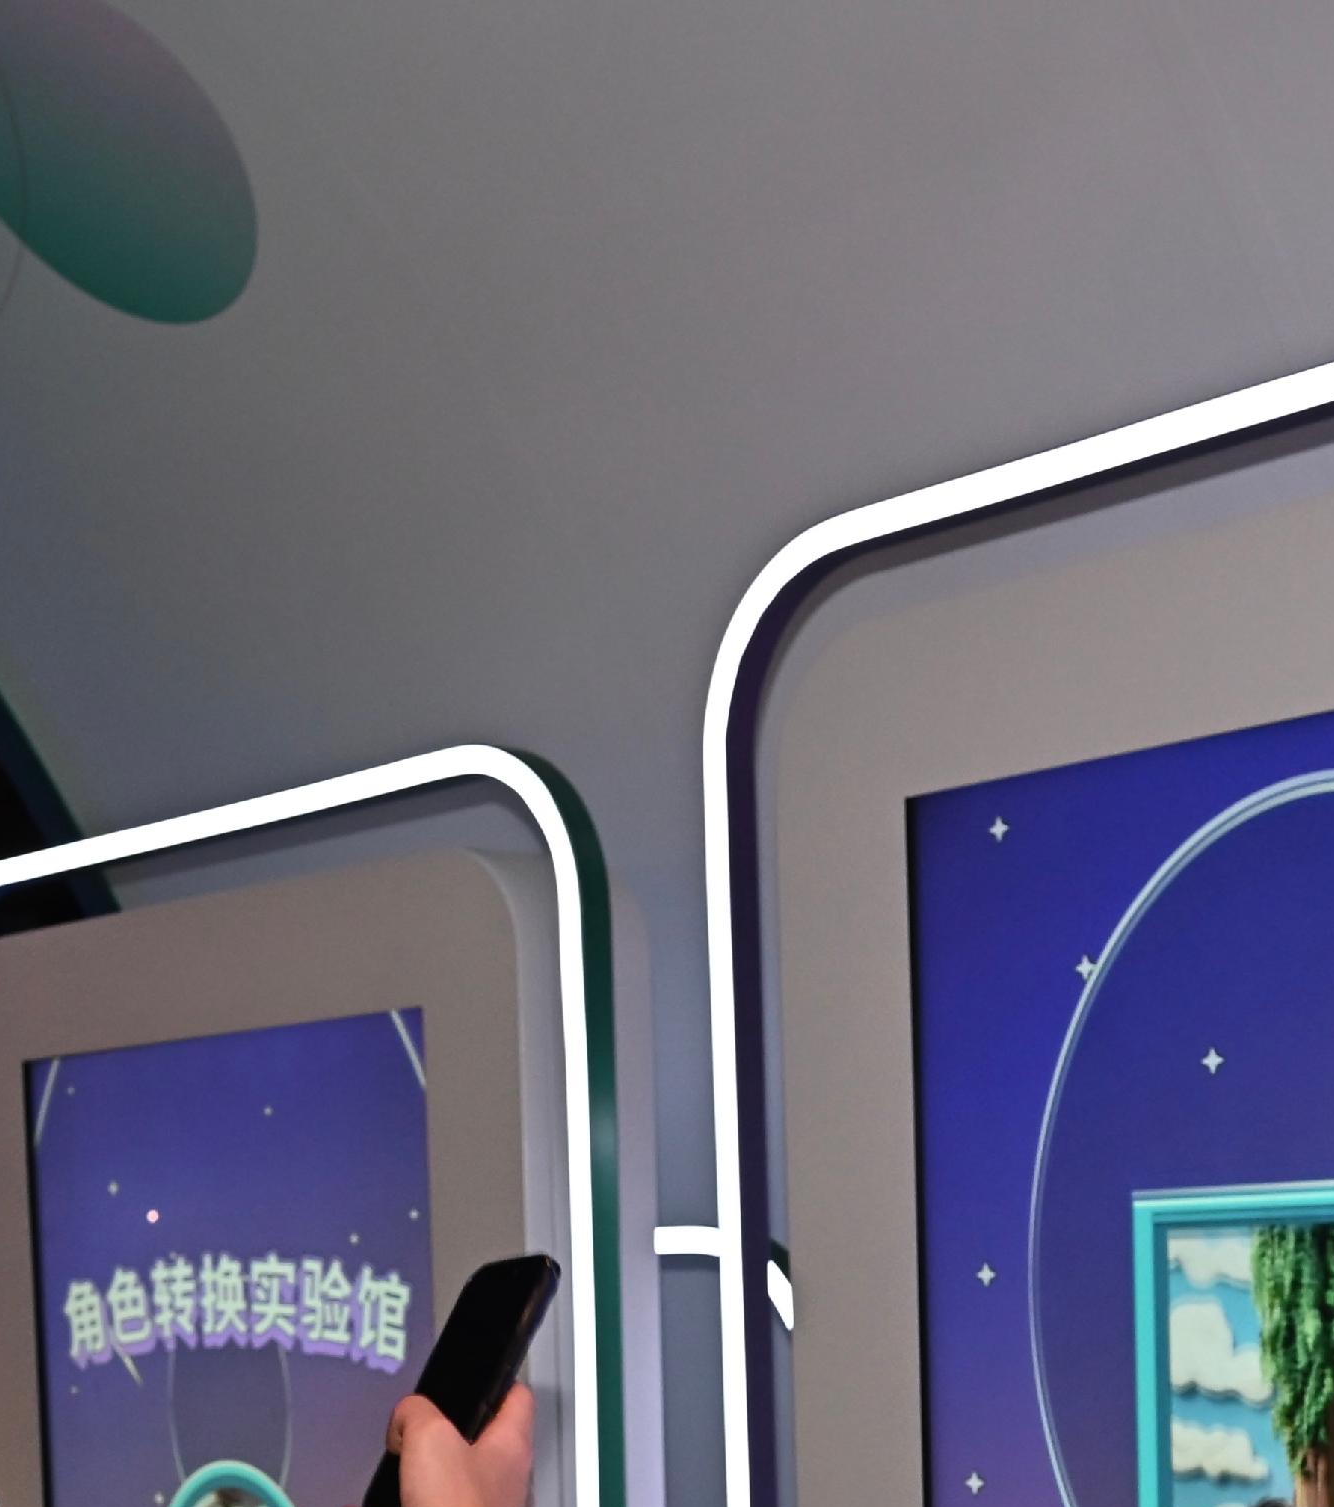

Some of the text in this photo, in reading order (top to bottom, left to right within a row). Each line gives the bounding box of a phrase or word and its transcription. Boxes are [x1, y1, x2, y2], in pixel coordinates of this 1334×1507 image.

[65, 1252, 411, 1372] 角色转换实验馆
